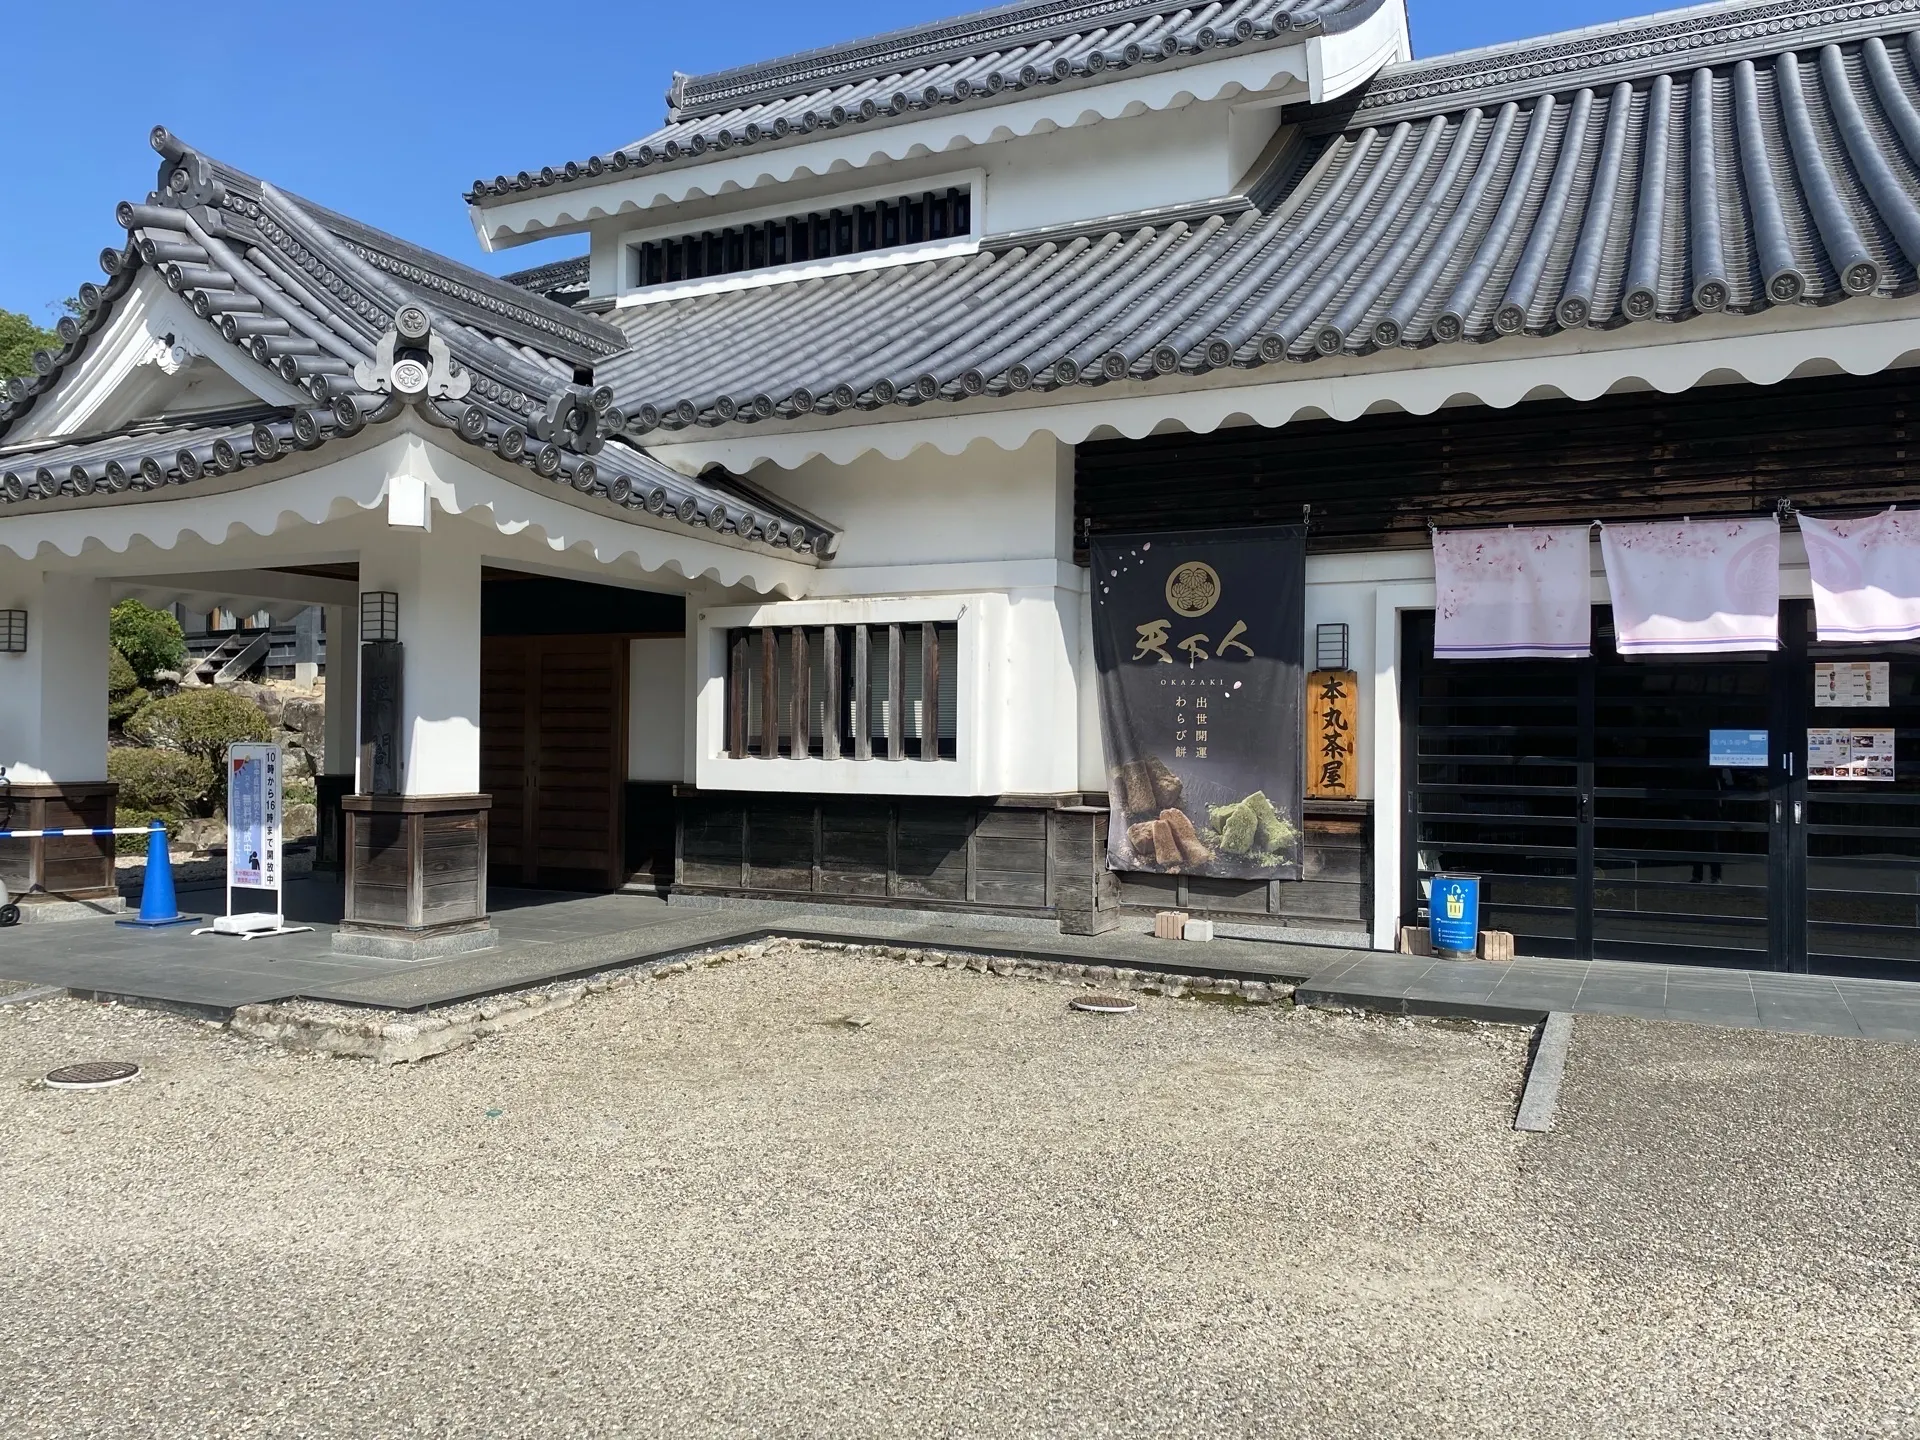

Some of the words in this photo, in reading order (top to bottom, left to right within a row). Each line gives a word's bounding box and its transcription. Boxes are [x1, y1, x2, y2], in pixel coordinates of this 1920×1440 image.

[1132, 618, 1255, 669] 天下人
[1160, 677, 1225, 686] OKAZAKI
[1175, 696, 1187, 758] わらび餅
[1195, 696, 1208, 759] 出世開運
[1319, 676, 1348, 789] 本丸茶屋
[266, 752, 276, 885] 10時から16時まで開放中
